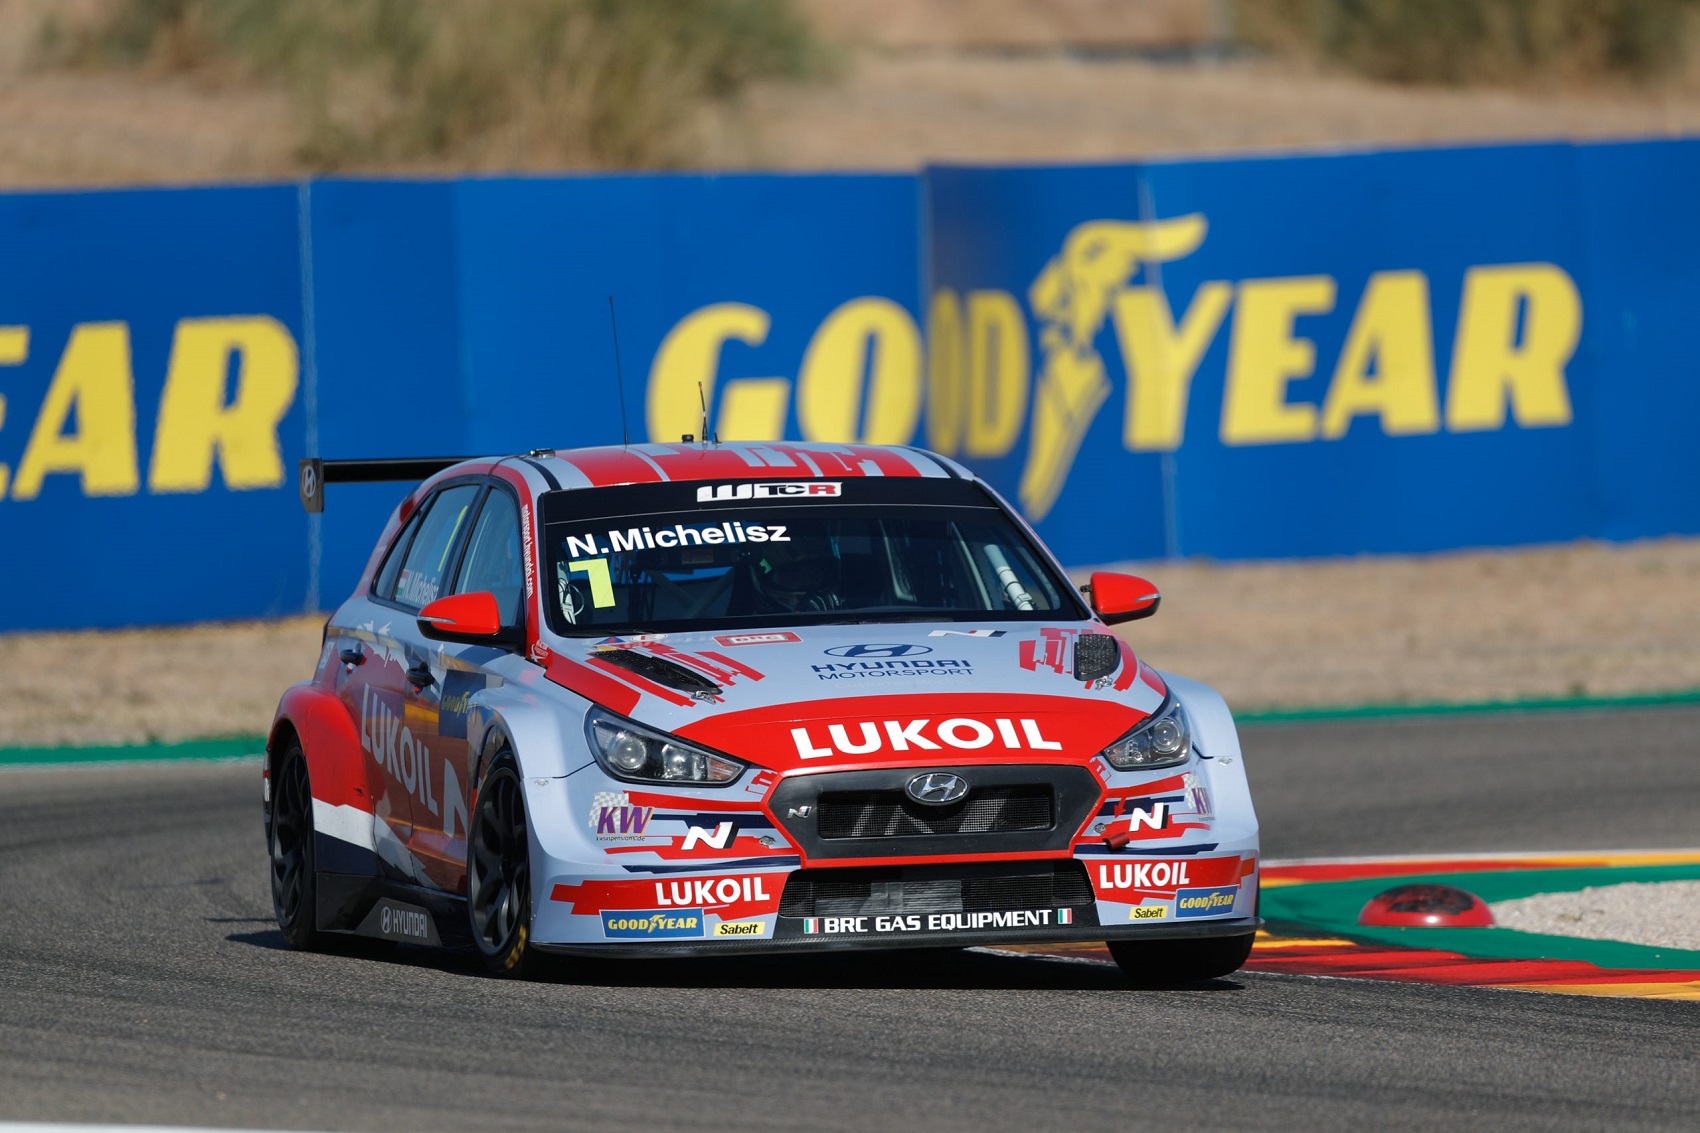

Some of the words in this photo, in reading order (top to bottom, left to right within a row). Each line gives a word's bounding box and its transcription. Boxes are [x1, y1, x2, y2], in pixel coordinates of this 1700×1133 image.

[697, 482, 842, 502] WTCR
[566, 521, 791, 558] N.Michelisz
[568, 558, 616, 609] 1
[810, 659, 972, 673] HYUNDAI
[818, 668, 974, 681] MOTORSPORT
[361, 682, 438, 817] LUKOIL
[790, 717, 1062, 760] LUKOIL
[597, 806, 655, 835] KW
[1099, 862, 1190, 889] LUKOIL
[655, 877, 770, 906] LUKOIL
[1179, 894, 1234, 910] GOODYEAR
[393, 908, 428, 938] HYUNDAI
[607, 914, 698, 933] GOODYEAR
[824, 918, 869, 934] BRC
[875, 915, 921, 932] GAS
[928, 910, 1052, 930] EQUIPMENT
[1134, 908, 1164, 919] Sabelt
[720, 924, 758, 936] Sabelt
